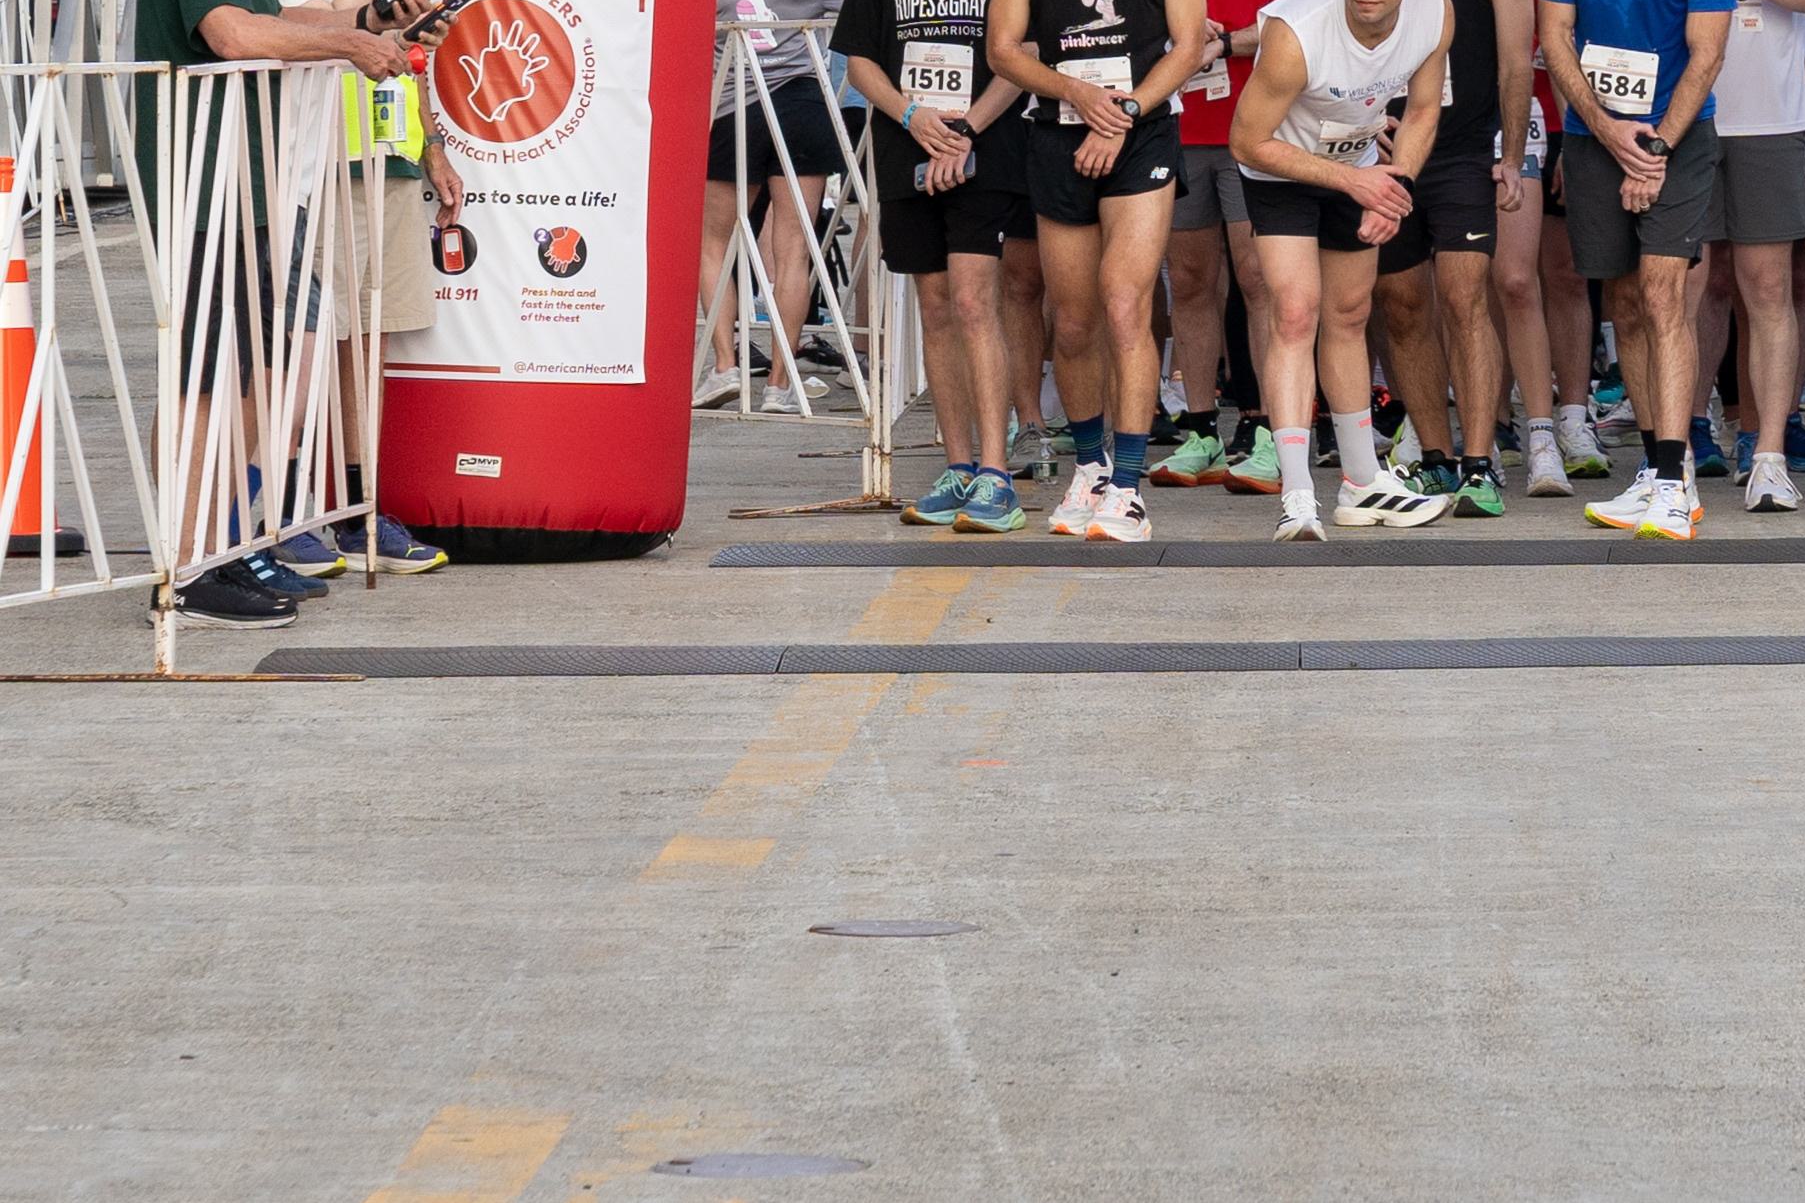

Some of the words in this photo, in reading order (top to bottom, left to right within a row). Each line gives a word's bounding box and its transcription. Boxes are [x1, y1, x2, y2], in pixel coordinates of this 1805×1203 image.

[897, 27, 920, 40] ROAD
[923, 25, 984, 37] WARRIORS
[1059, 34, 1126, 51] pinkracer
[908, 67, 962, 91] 1518
[1587, 71, 1647, 99] 1584
[503, 138, 556, 164] Heart
[491, 190, 510, 204] to
[516, 193, 560, 205] save
[565, 194, 576, 206] a
[581, 191, 616, 207] life!
[537, 230, 548, 242] 2
[435, 287, 452, 300] all
[455, 288, 479, 301] 911
[521, 287, 548, 297] Press
[551, 287, 575, 297] hard
[577, 288, 596, 297] and
[520, 300, 542, 310] fast
[544, 301, 554, 310] in
[556, 301, 573, 310] the
[575, 303, 605, 311] center
[520, 313, 532, 322] of
[534, 313, 551, 322] the
[553, 314, 580, 322] chest
[514, 361, 634, 375] @AmericanHeartMA
